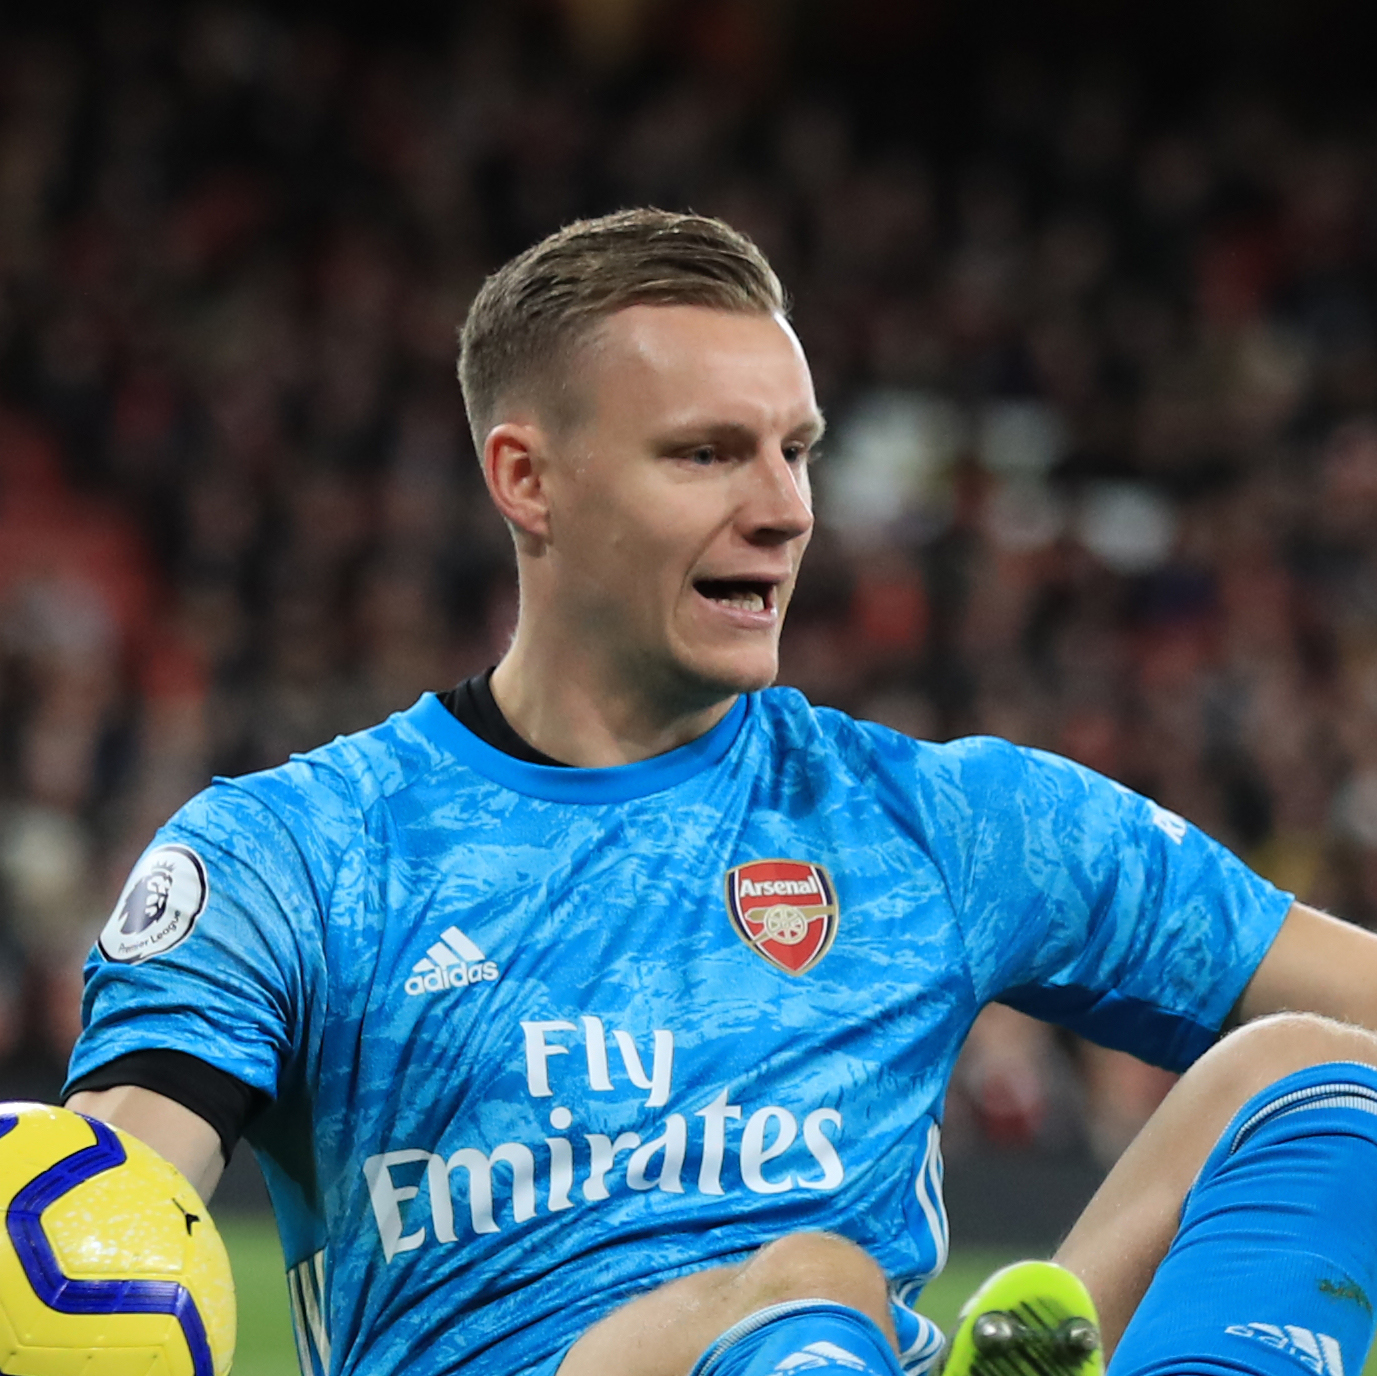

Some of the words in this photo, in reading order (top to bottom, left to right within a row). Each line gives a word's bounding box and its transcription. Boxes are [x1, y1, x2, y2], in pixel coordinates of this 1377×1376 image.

[740, 875, 819, 897] Arsenal
[150, 910, 181, 943] League
[404, 961, 500, 995] adidas
[520, 1016, 674, 1107] Fly
[363, 1090, 845, 1264] Emirates
